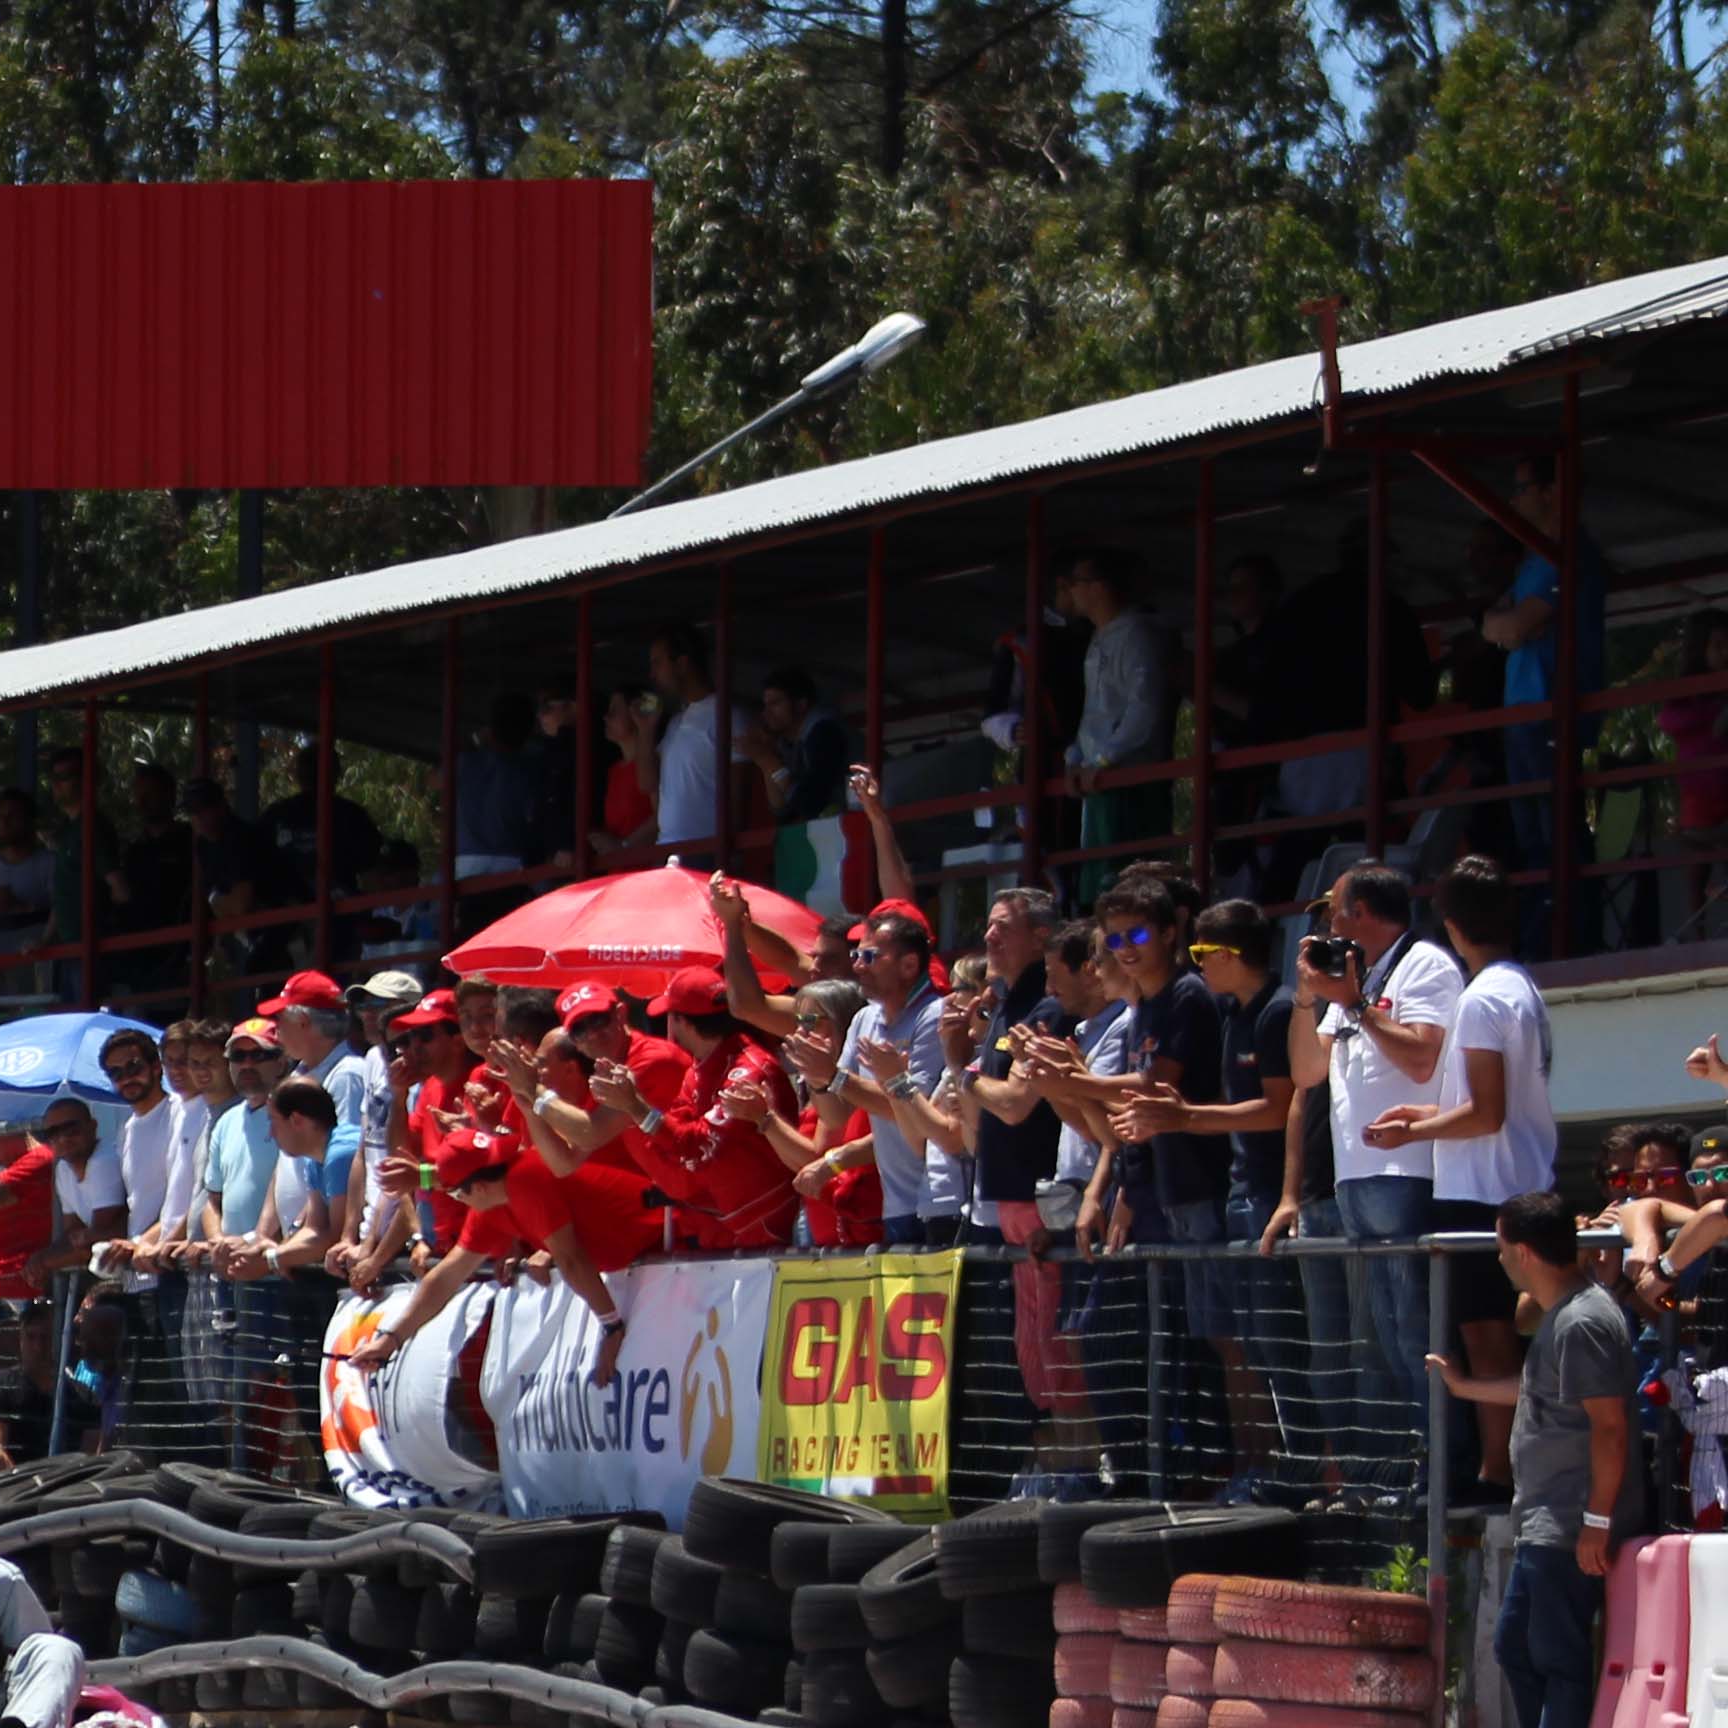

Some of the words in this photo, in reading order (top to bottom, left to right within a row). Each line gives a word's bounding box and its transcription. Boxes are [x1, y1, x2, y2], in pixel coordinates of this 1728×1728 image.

[779, 1292, 949, 1406] GAS
[512, 1358, 671, 1454] multicare
[773, 1436, 860, 1473] RACING
[872, 1432, 938, 1471] TEAM
